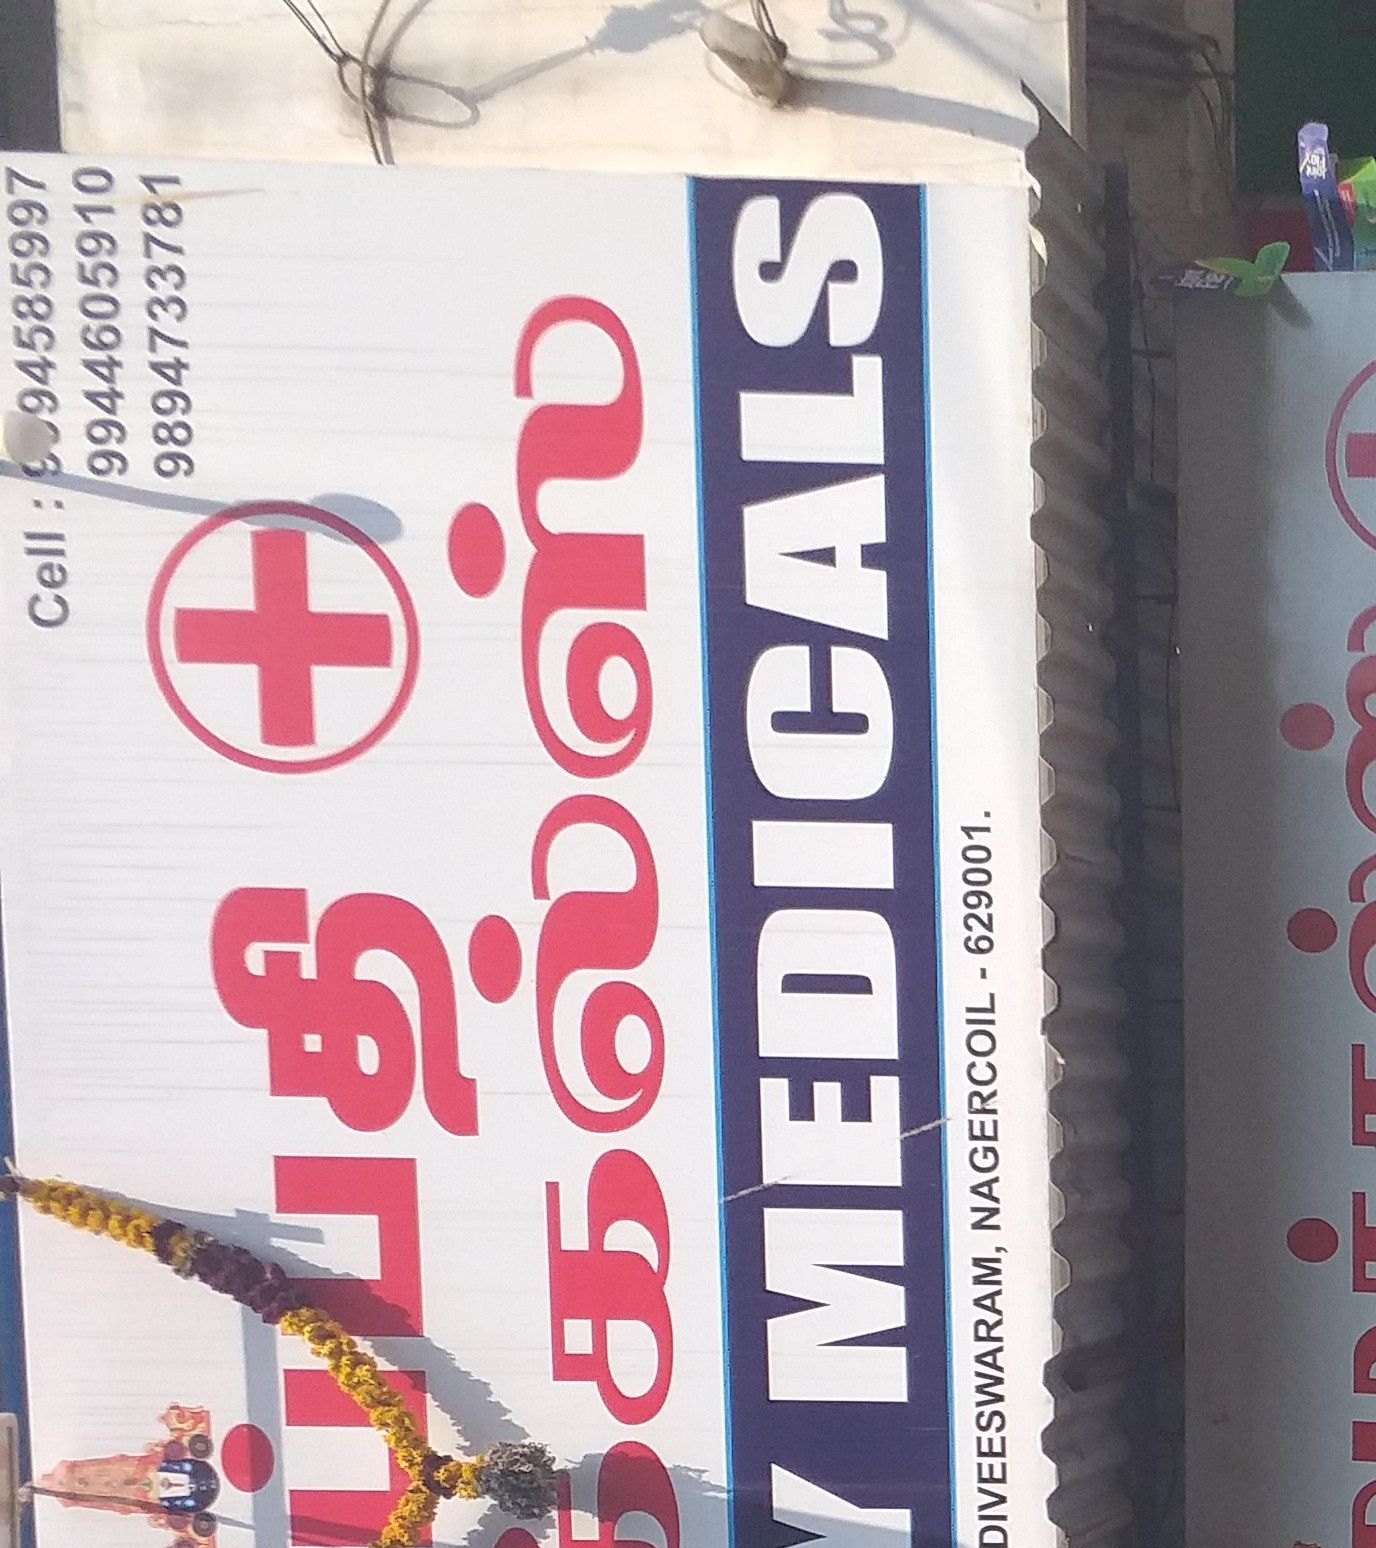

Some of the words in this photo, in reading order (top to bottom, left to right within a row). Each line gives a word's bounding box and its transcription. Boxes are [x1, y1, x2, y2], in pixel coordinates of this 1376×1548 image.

[5, 165, 61, 479] 994585997
[72, 165, 128, 478] 9944605910
[139, 171, 195, 478] 9894733781
[25, 530, 70, 630] Cell
[732, 190, 910, 1404] MEDICALS
[960, 809, 994, 956] 629001.
[965, 991, 1002, 1232] NAGERCOIL
